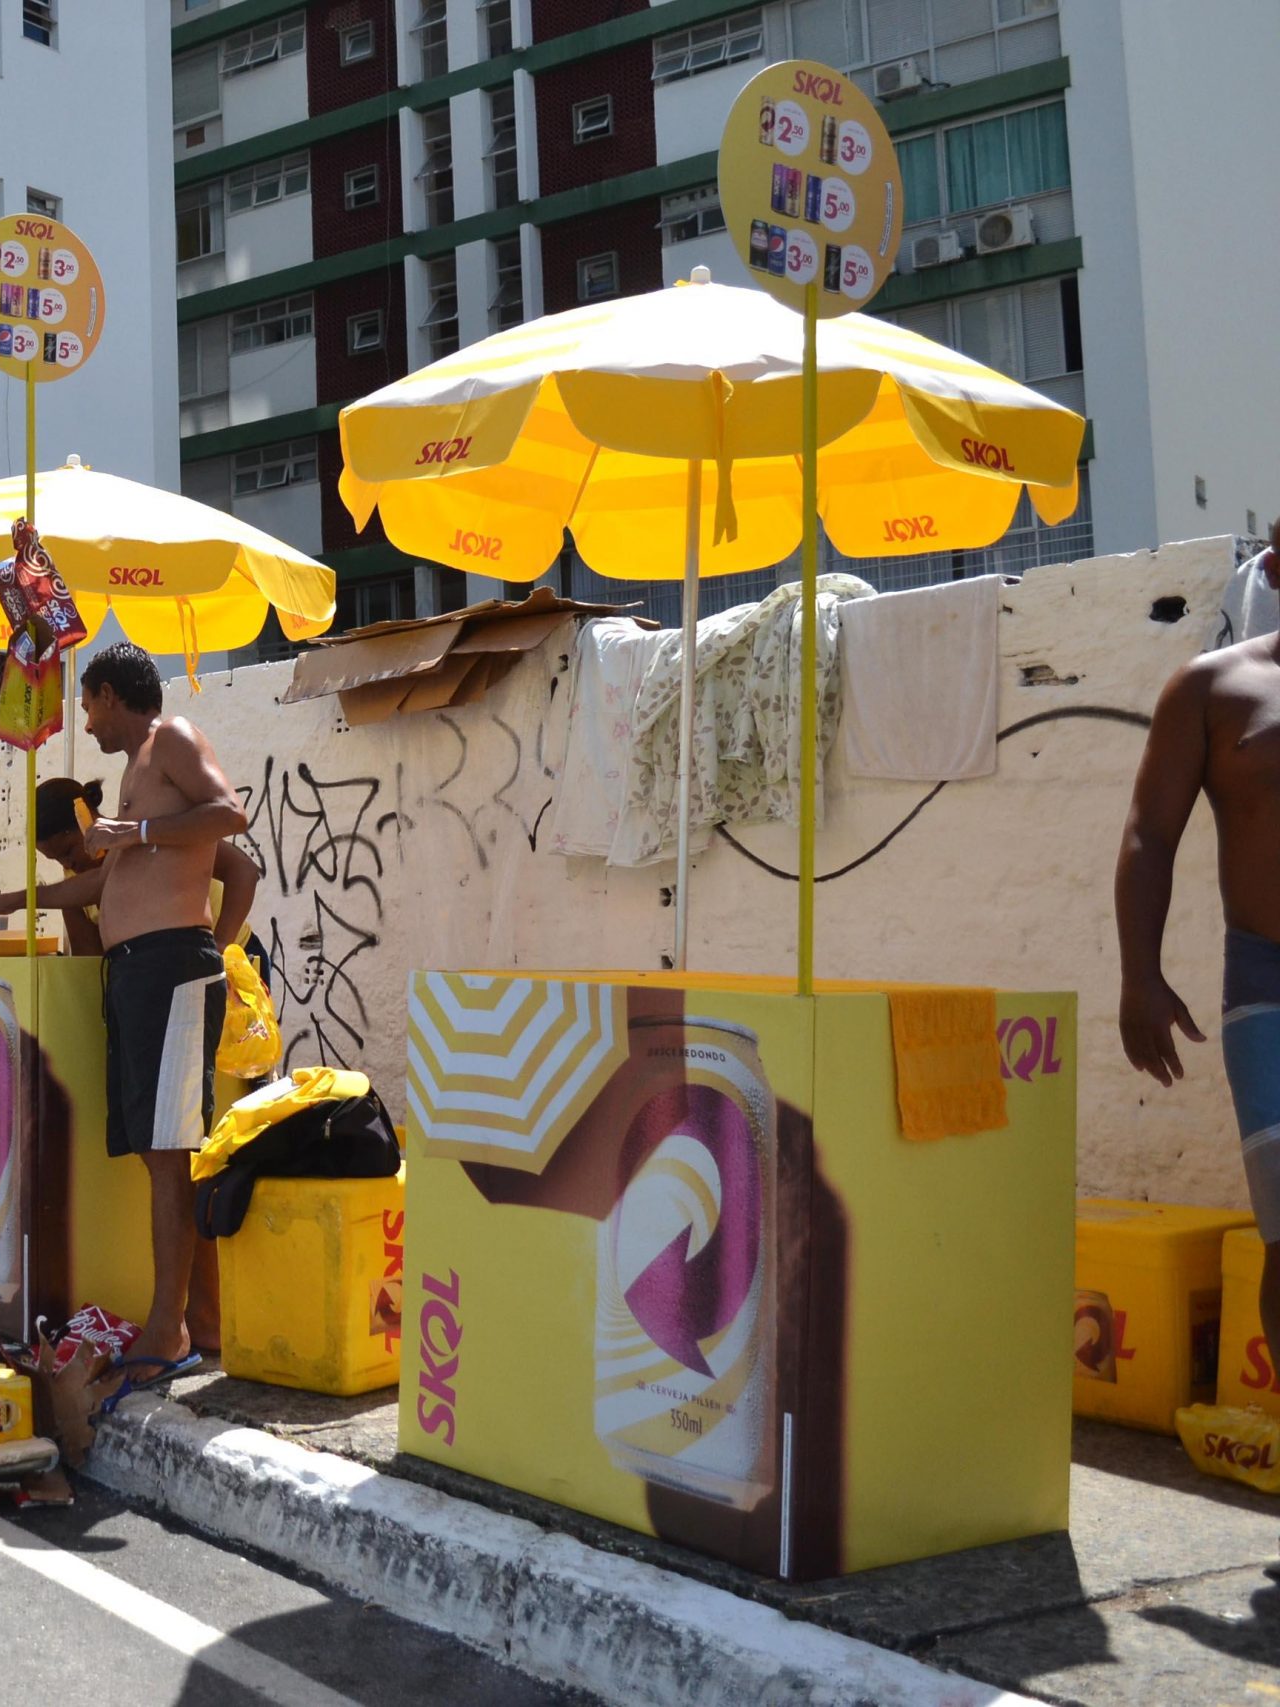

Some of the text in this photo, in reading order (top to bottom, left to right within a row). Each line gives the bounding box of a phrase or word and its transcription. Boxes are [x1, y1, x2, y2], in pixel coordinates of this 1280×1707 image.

[793, 70, 843, 106] SKOL
[14, 219, 55, 240] SKOL
[416, 436, 472, 465] SKOL
[961, 438, 1015, 471] SKOL
[109, 567, 164, 587] SKOL
[47, 600, 71, 631] SKOL
[417, 1268, 464, 1447] SKOL
[650, 1383, 721, 1411] CERVEJA PILSEN
[670, 1408, 703, 1435] 350ml
[1205, 1433, 1275, 1469] SKOL
